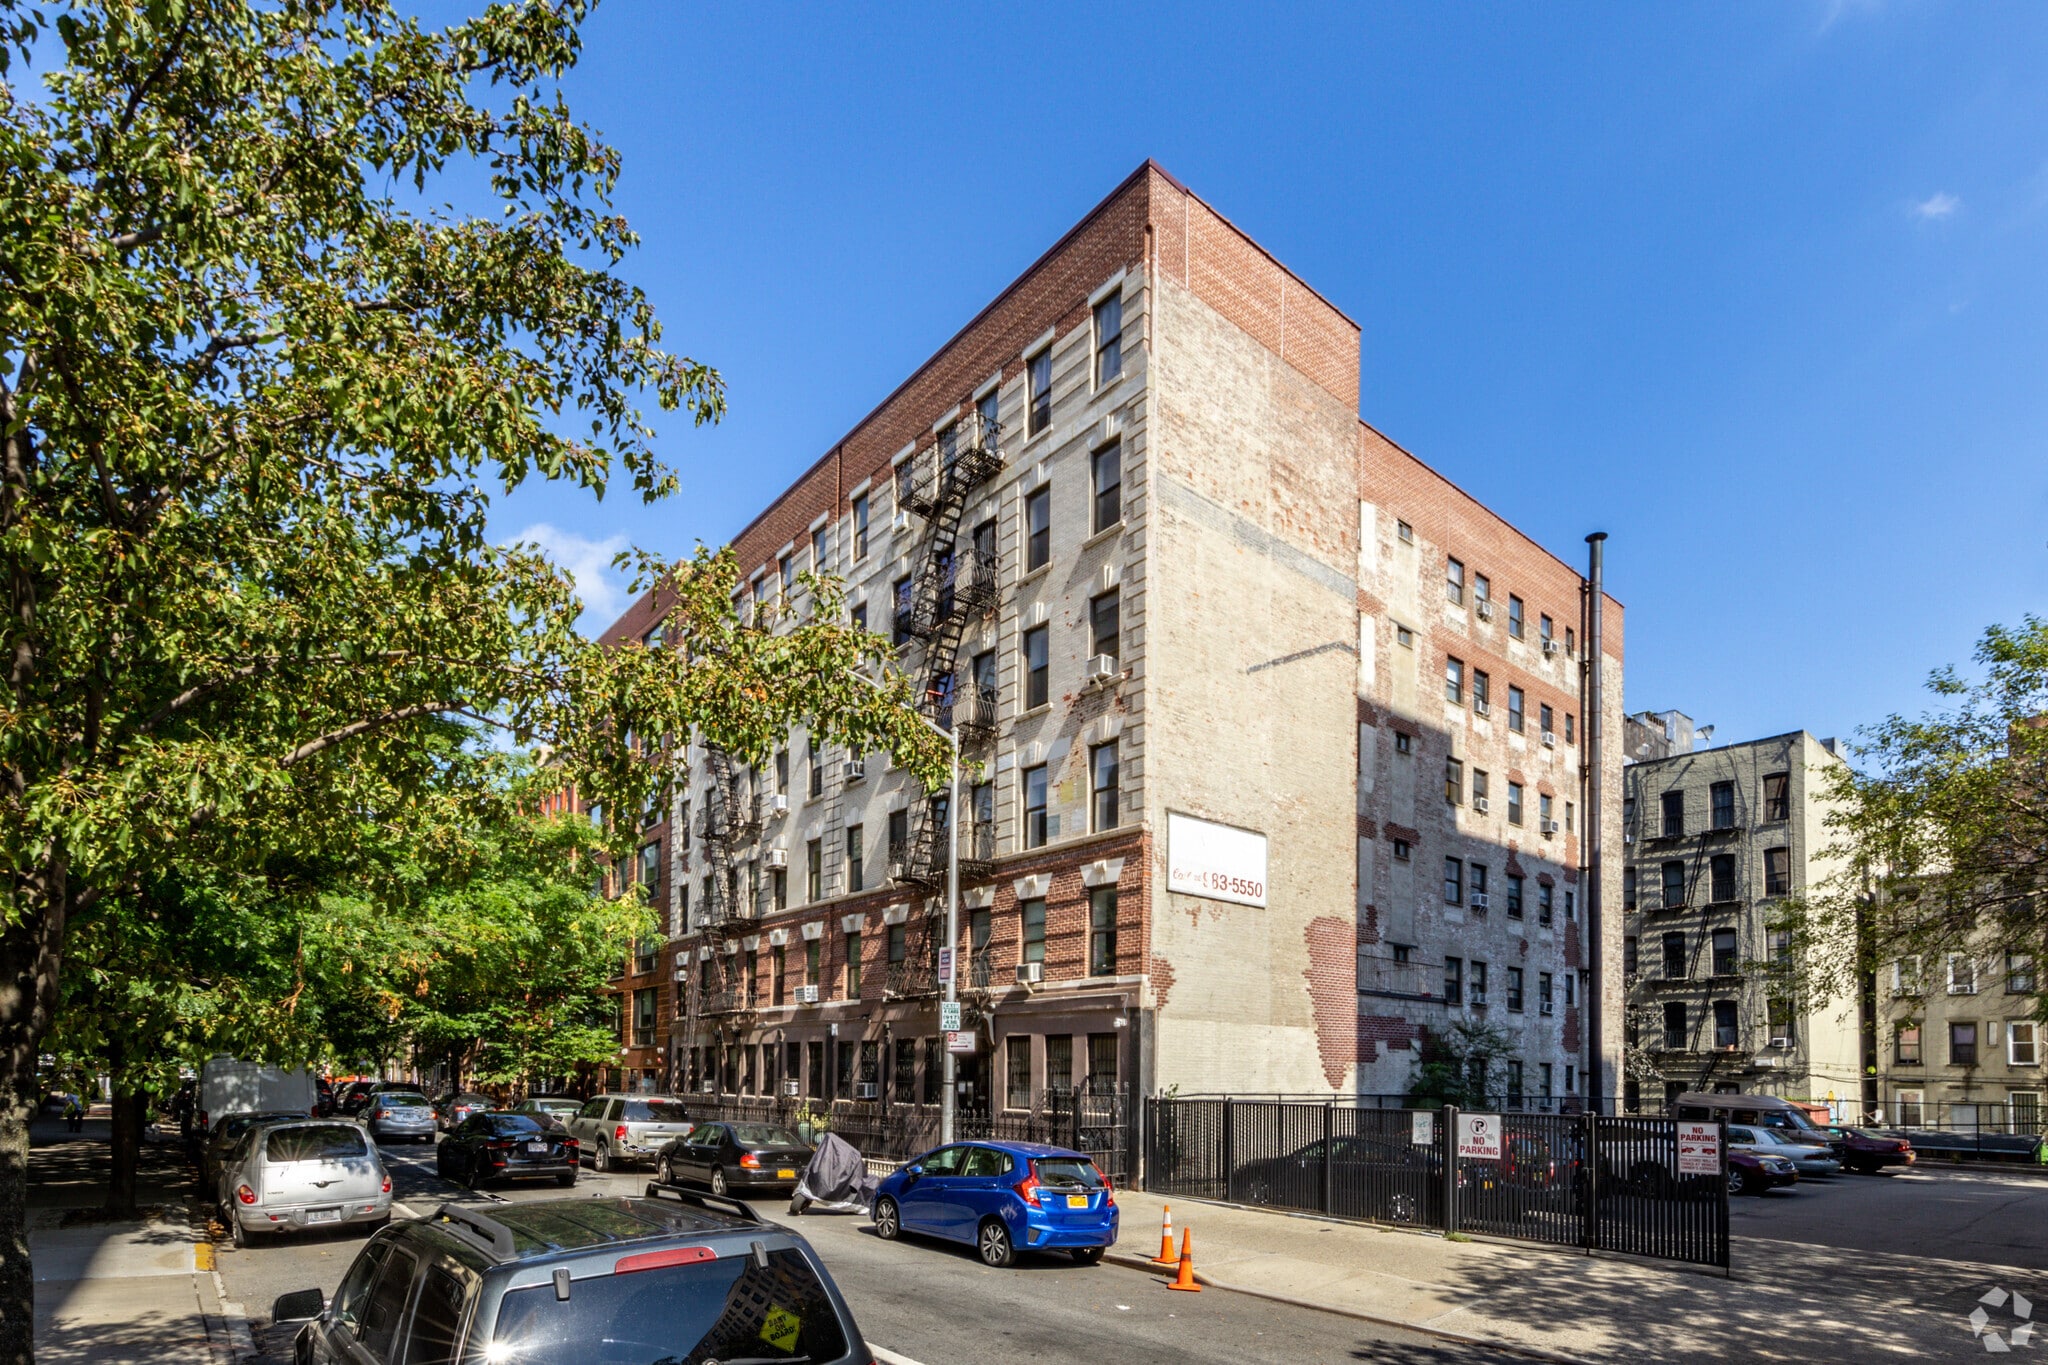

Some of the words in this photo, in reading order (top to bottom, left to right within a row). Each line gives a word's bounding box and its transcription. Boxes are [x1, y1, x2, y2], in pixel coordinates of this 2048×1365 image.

[1472, 1136, 1485, 1145] NO
[1680, 1134, 1716, 1142] PARKING
[1459, 1145, 1498, 1156] PARKING
[768, 1314, 787, 1328] BABY
[775, 1321, 785, 1331] ON
